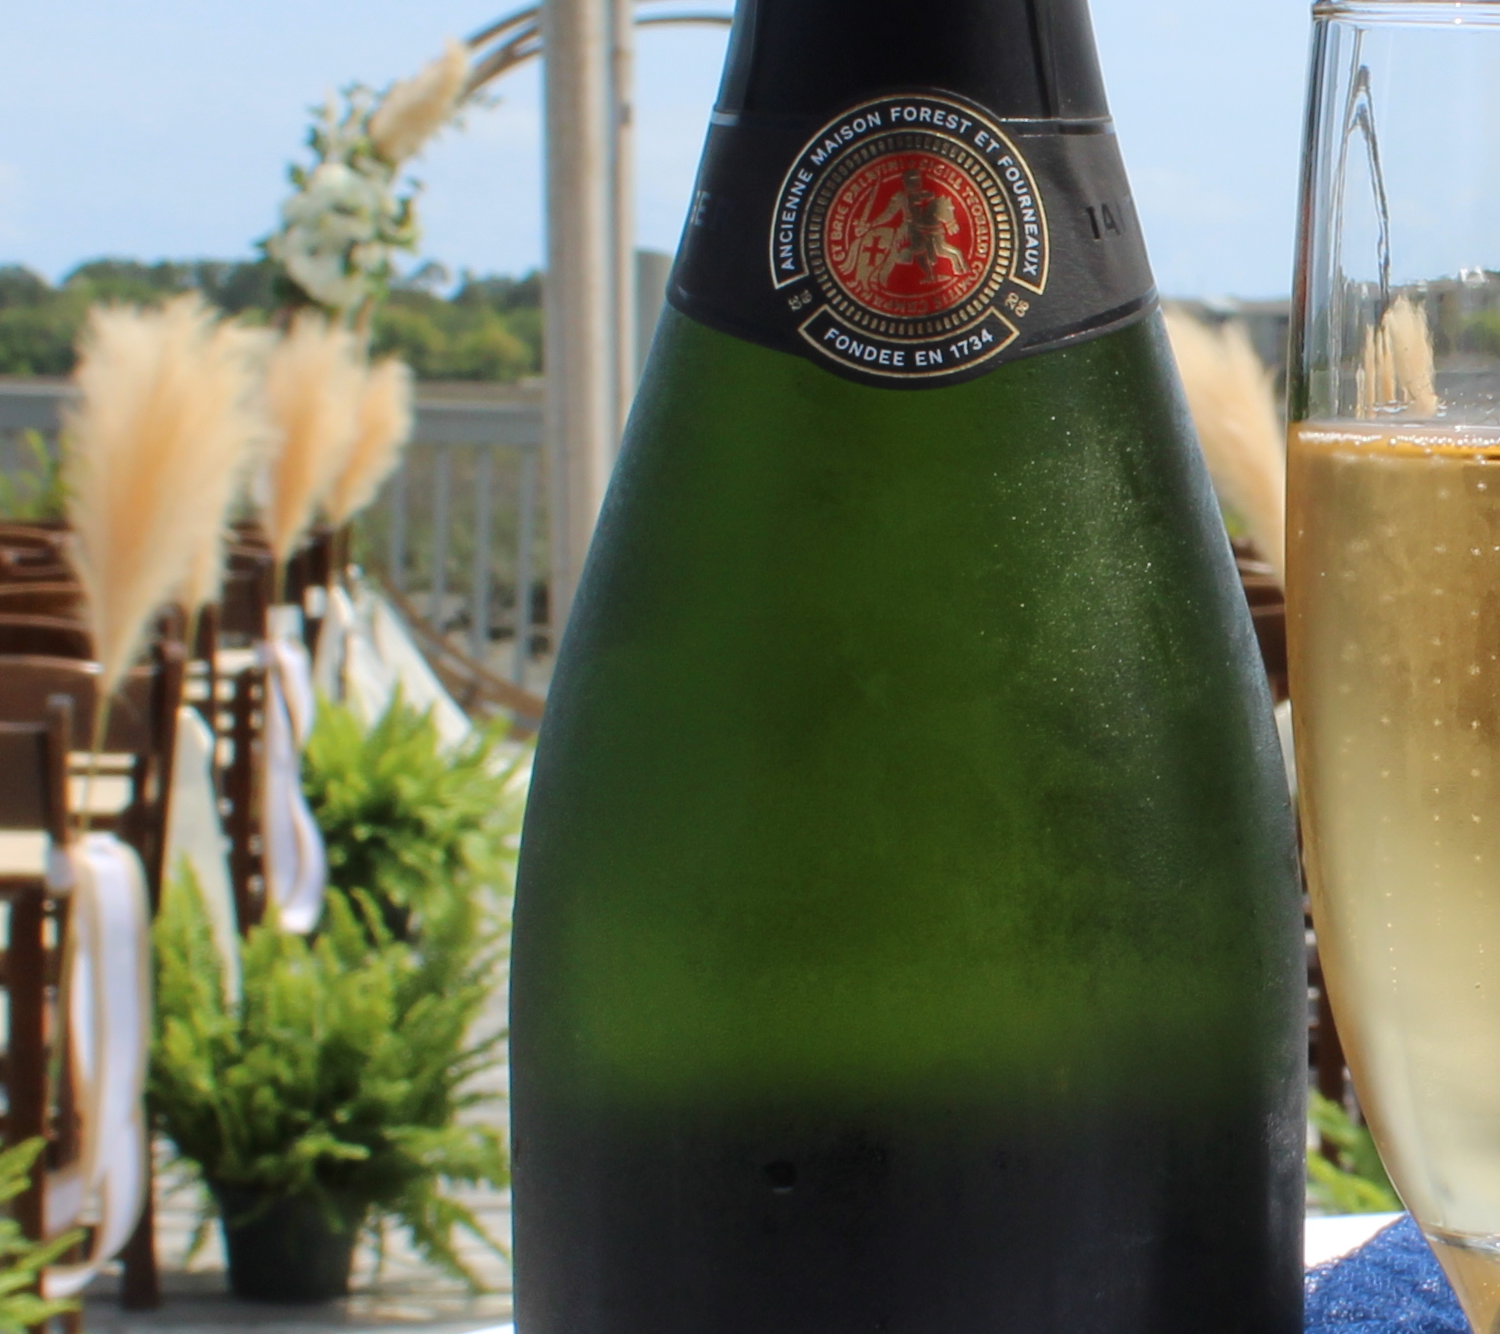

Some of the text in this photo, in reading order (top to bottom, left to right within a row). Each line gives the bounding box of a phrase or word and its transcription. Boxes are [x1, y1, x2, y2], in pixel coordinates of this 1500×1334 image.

[780, 168, 814, 271] ANCIENNE
[812, 111, 882, 166] MAISON
[890, 106, 973, 134] FOREST
[973, 128, 1000, 154] ET
[998, 156, 1040, 276] FOURNEAUX
[823, 327, 994, 366] FONDEE EN 1734
